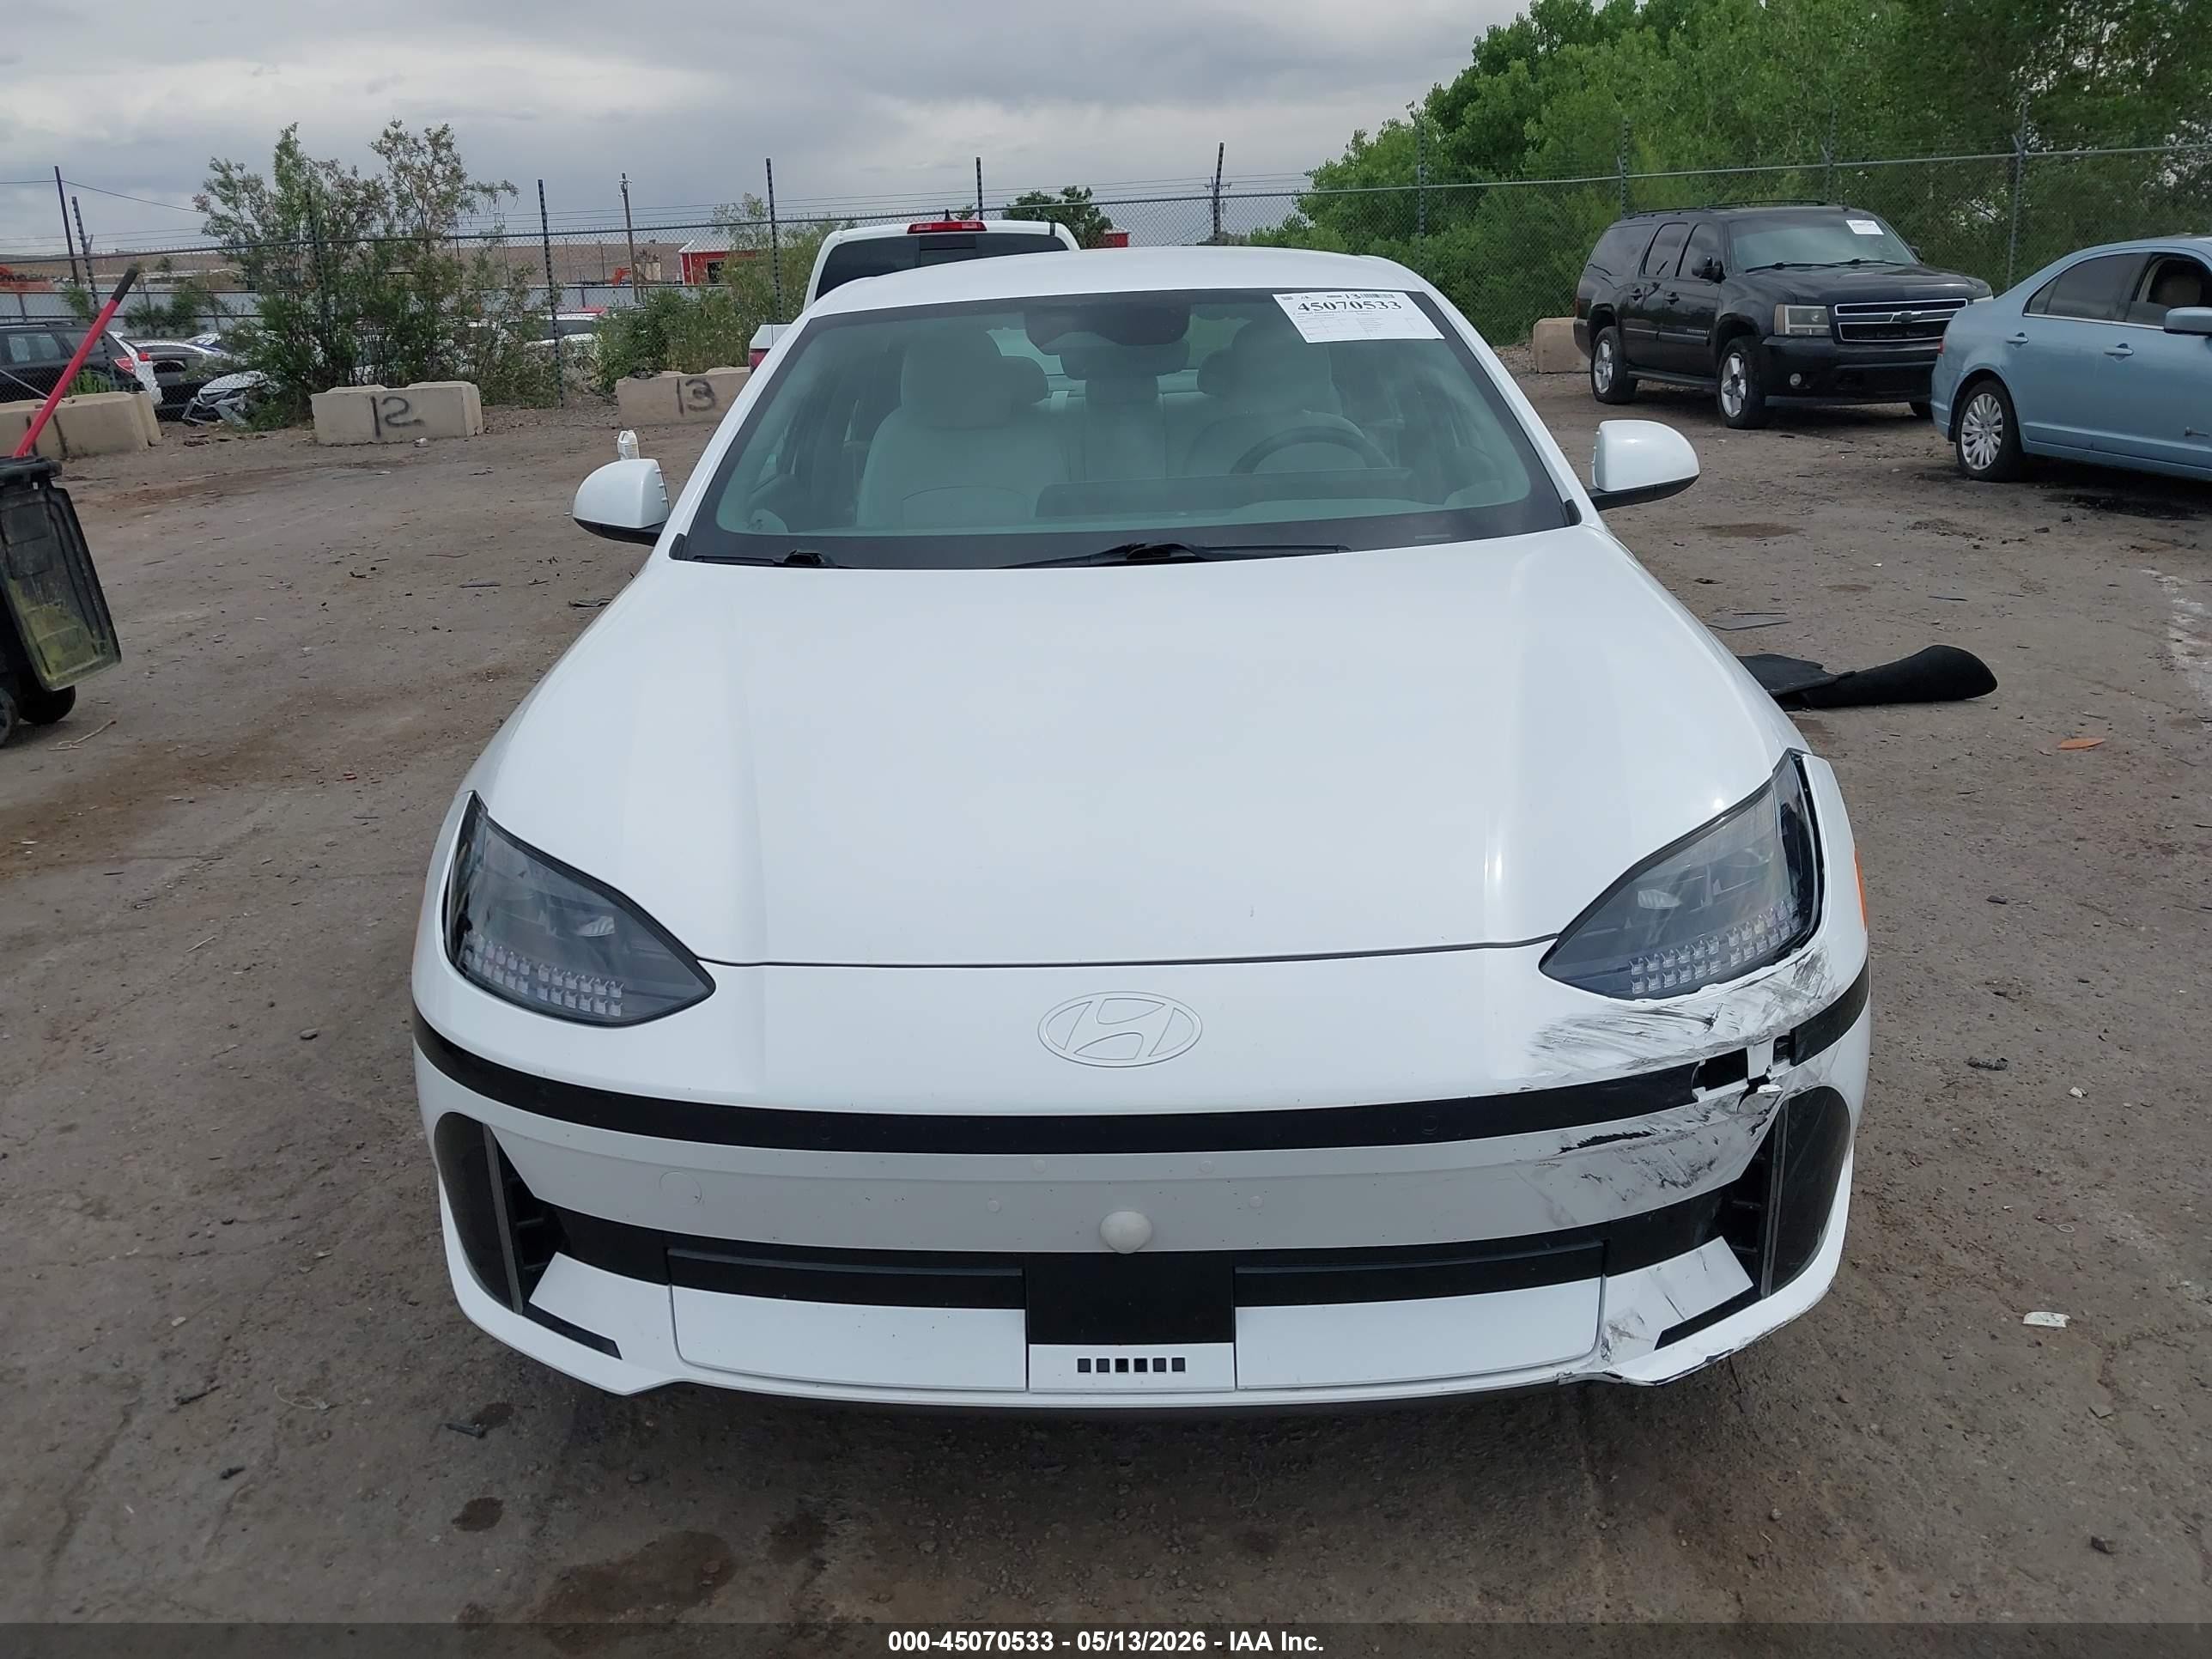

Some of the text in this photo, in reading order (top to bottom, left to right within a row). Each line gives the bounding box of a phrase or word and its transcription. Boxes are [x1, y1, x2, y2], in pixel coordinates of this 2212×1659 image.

[1297, 301, 1402, 312] 45070533
[370, 396, 426, 438] 12
[677, 378, 716, 417] 13
